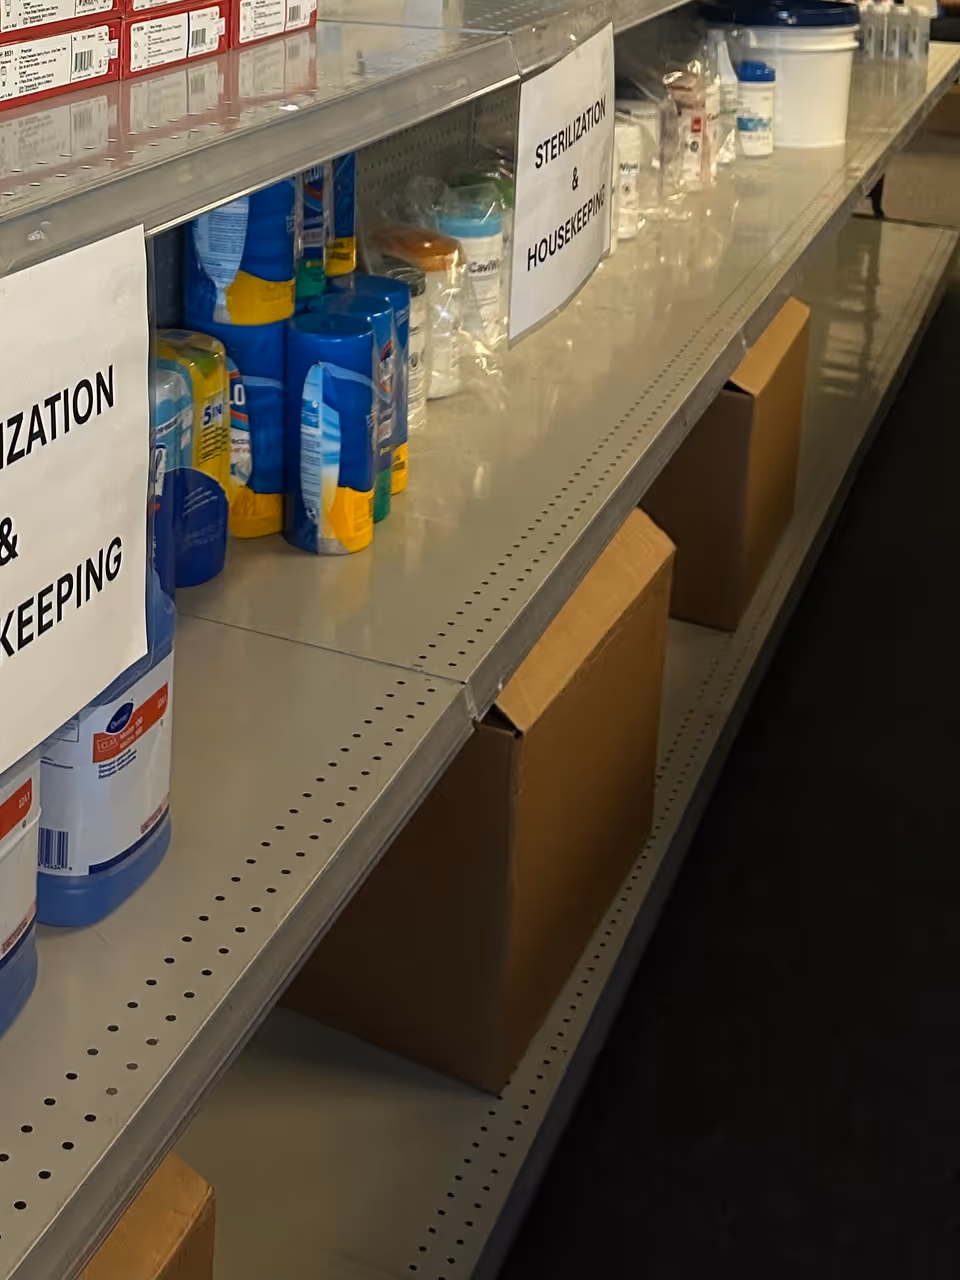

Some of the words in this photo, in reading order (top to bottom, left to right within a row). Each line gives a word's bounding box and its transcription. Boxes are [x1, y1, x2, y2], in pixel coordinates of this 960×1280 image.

[535, 94, 606, 169] STERILIZATION
[571, 167, 579, 191] &
[527, 184, 605, 272] HOUSEKEEPING
